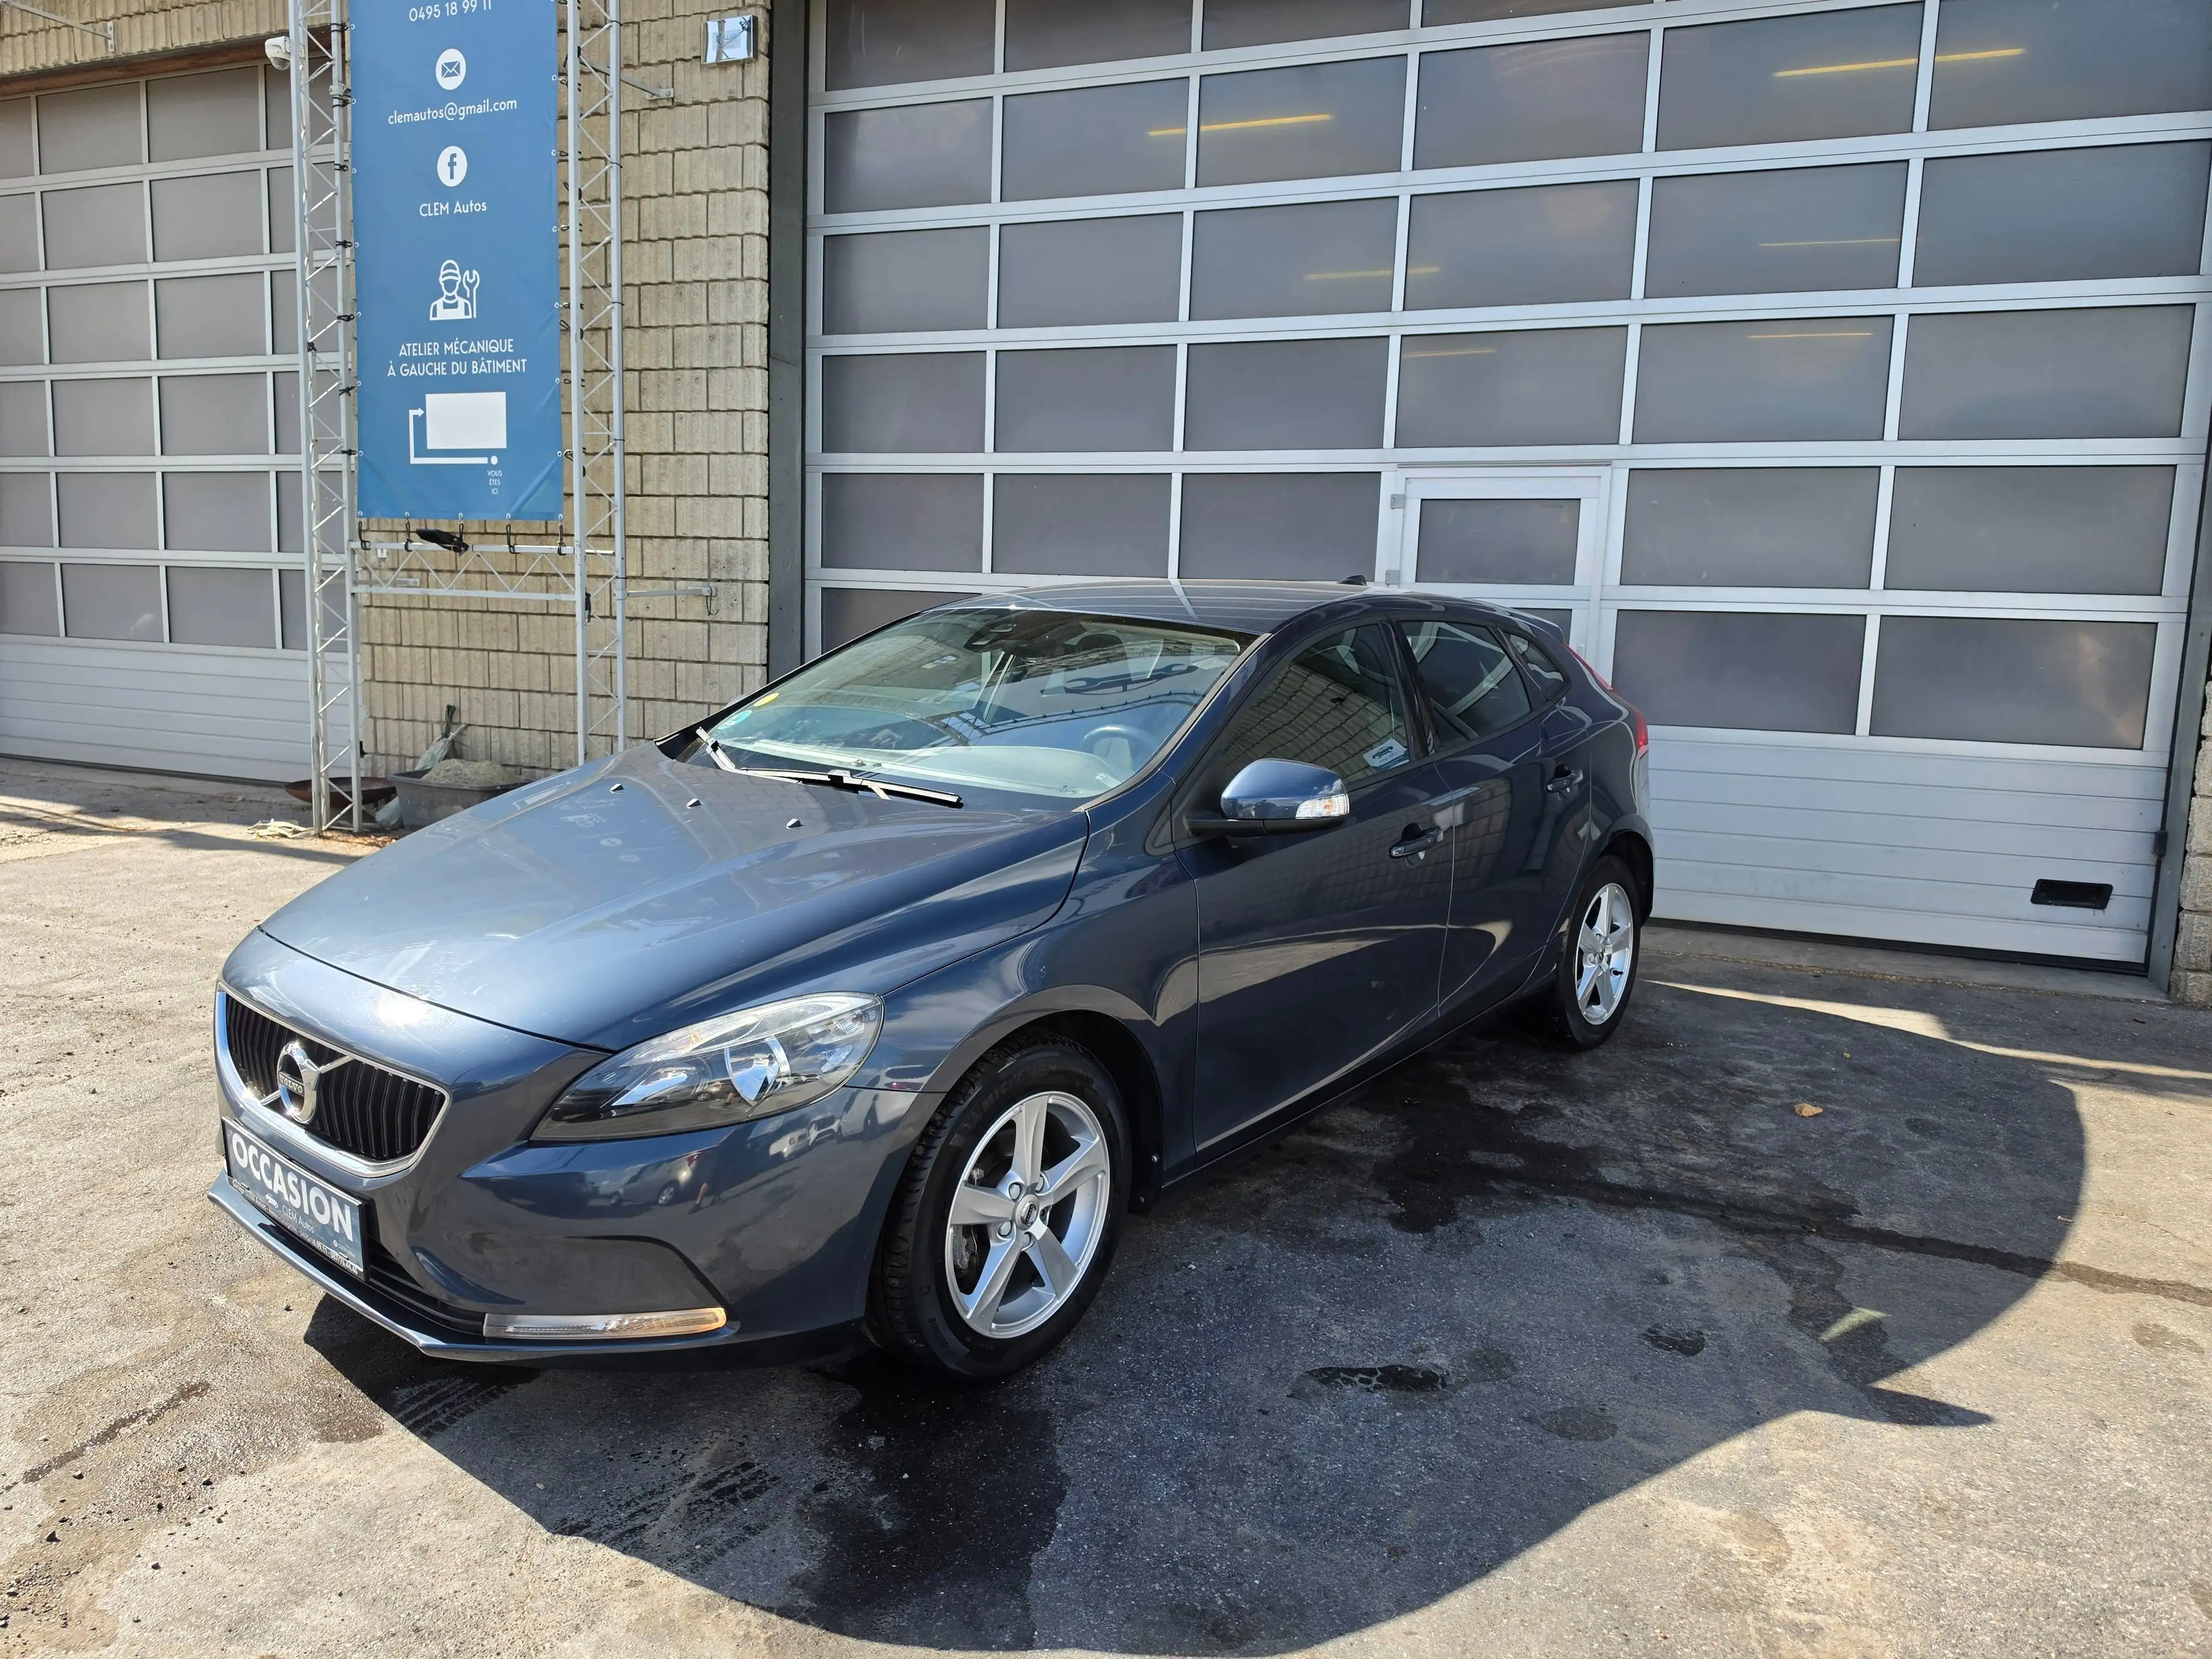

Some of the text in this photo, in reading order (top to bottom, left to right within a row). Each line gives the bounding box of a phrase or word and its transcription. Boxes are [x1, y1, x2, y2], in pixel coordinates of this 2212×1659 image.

[409, 0, 491, 22] 0495 18 99 11
[388, 99, 517, 124] clemautos@gmail.com
[419, 200, 487, 217] CLEM Autos
[399, 338, 514, 357] ATELIER MÉCANIQUE
[387, 357, 527, 377] À GAUCHE DU BÂTIMENT
[279, 1074, 303, 1093] VOLVO
[232, 1132, 353, 1242] OCCASION
[282, 1205, 315, 1233] CLEM Autos
